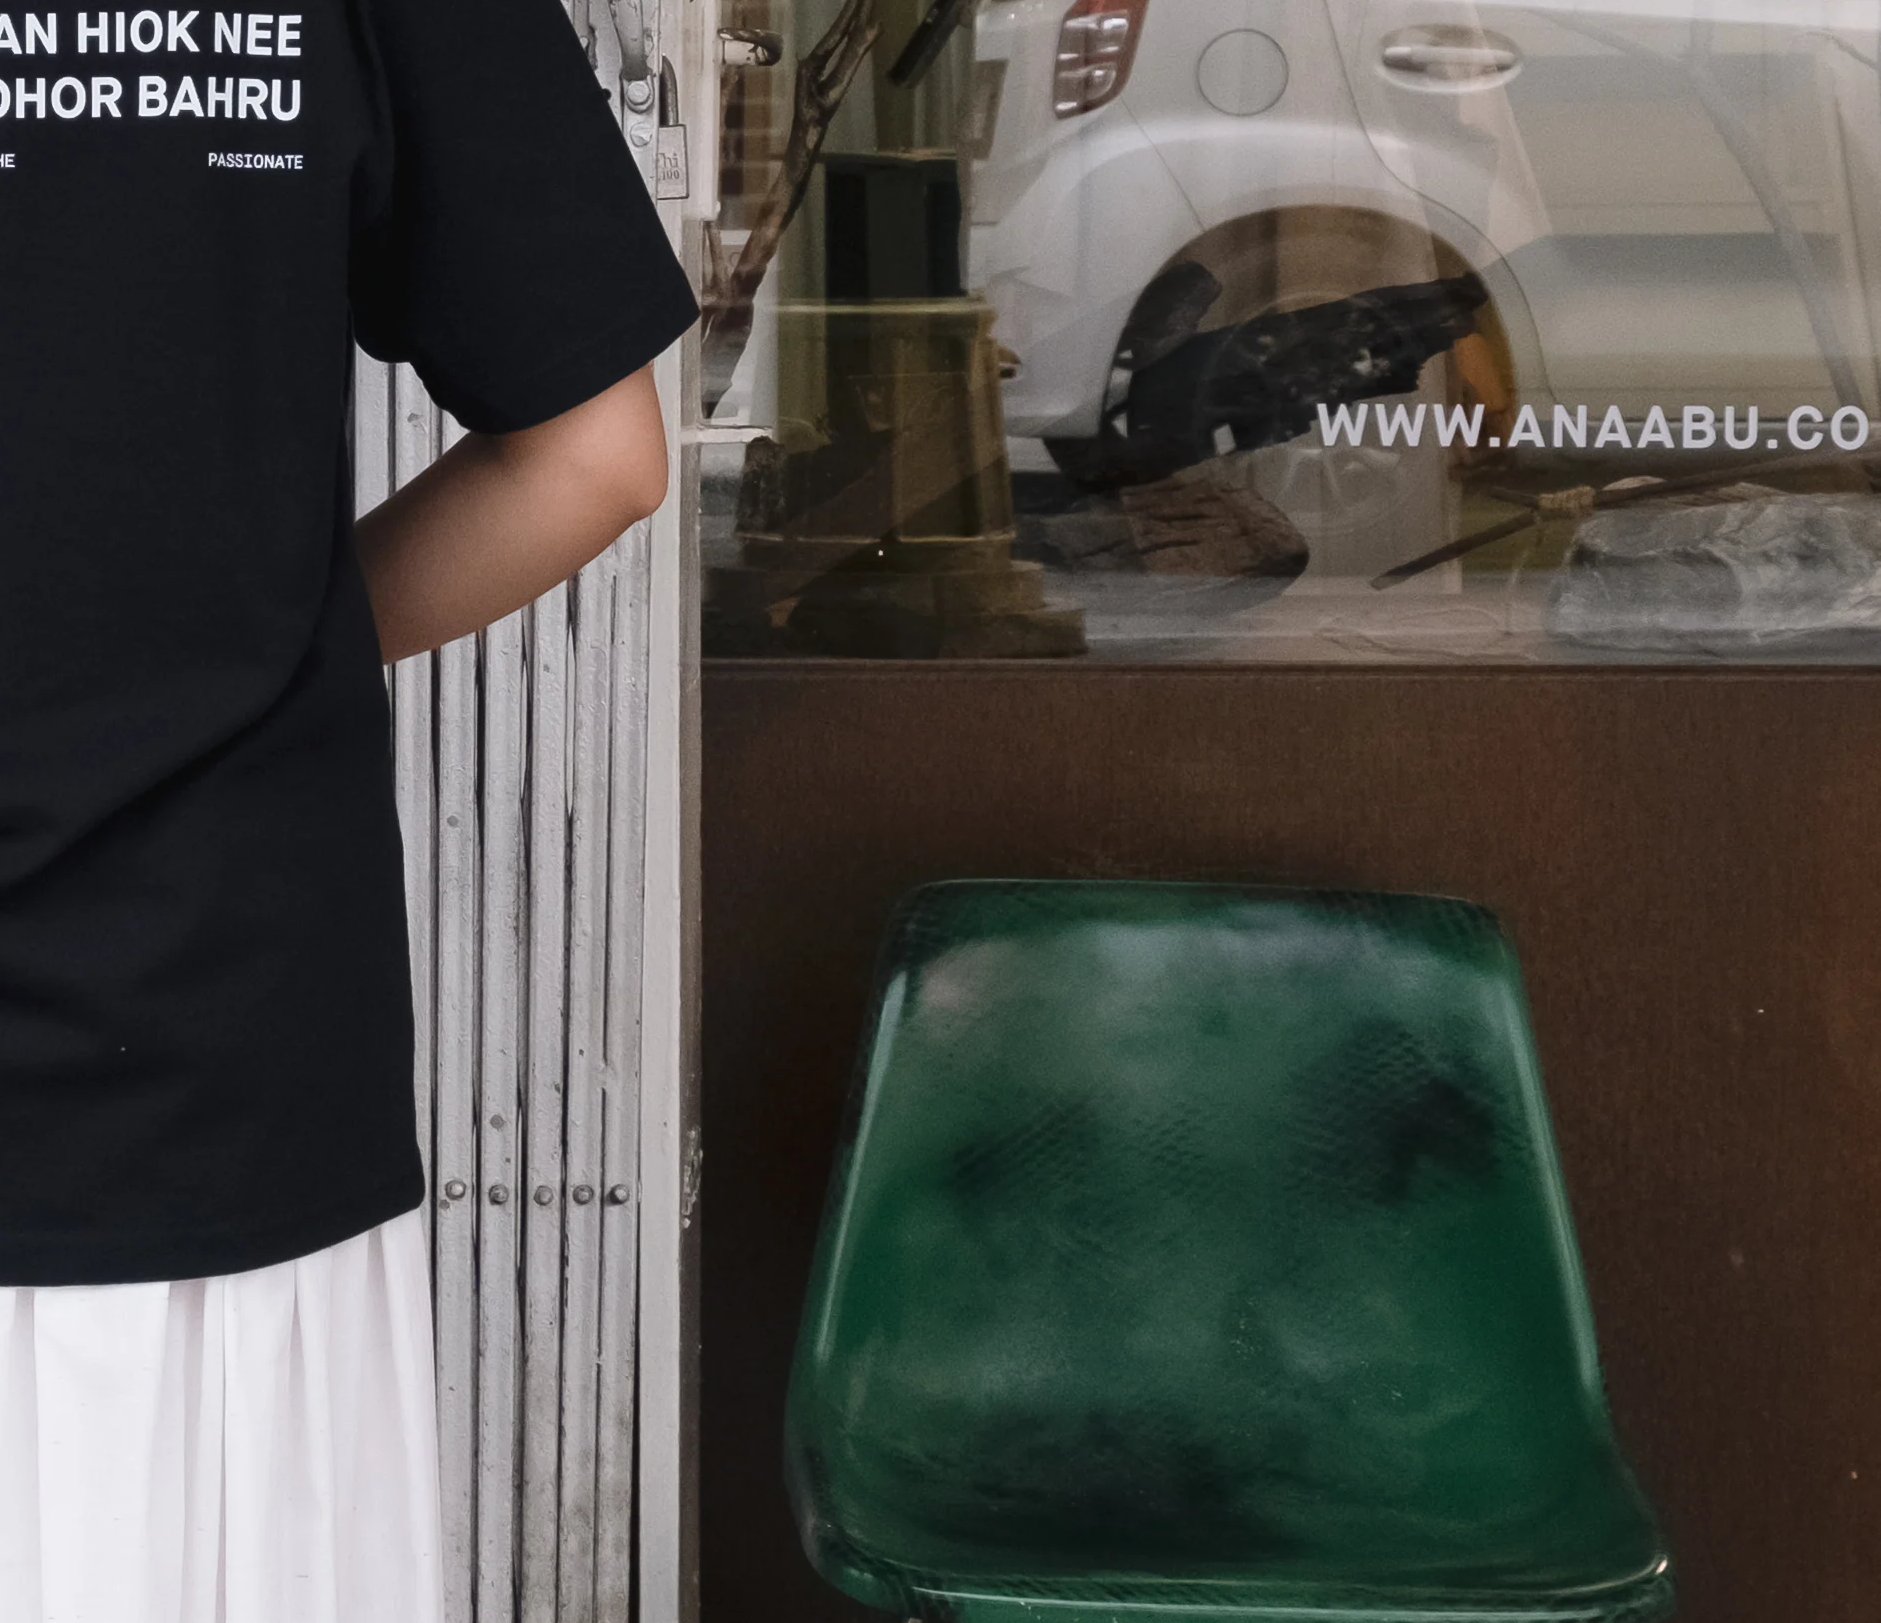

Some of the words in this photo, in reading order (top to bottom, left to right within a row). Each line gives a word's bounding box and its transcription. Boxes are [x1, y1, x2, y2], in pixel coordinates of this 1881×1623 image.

[77, 9, 201, 54] HIOK
[214, 11, 303, 57] NEE
[137, 75, 301, 122] BAHRU
[208, 152, 304, 170] PASSIONATE
[1317, 403, 1869, 450] WWW.ANAABU.CO
